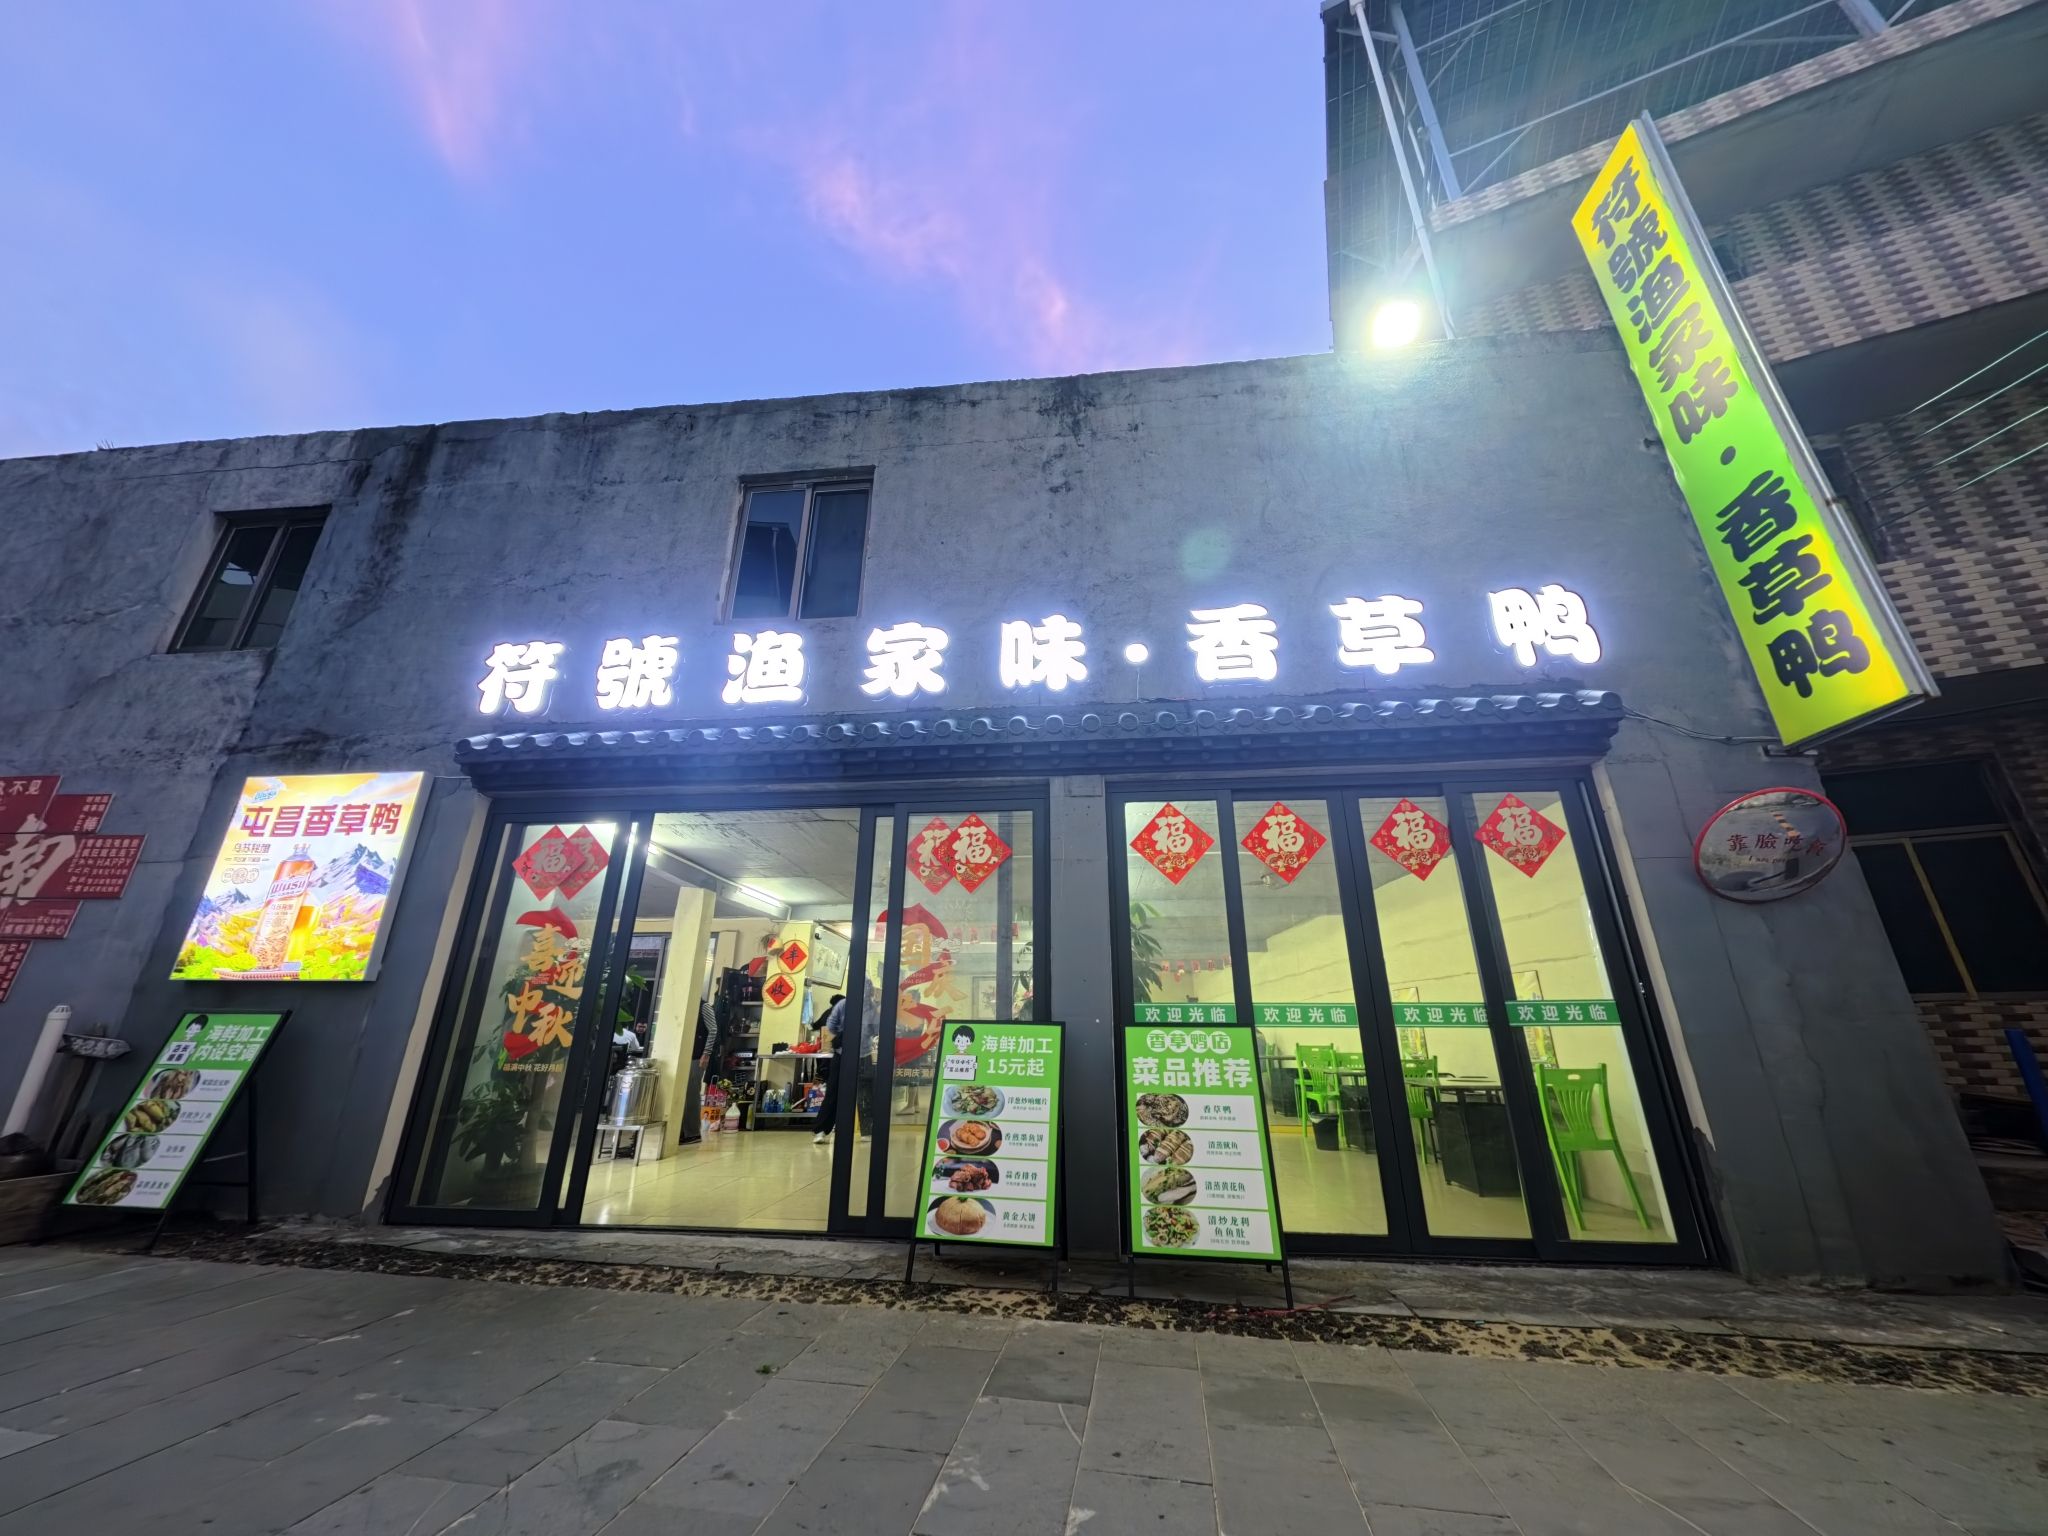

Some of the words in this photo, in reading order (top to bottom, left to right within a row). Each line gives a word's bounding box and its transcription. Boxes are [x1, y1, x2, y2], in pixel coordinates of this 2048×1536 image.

[1592, 157, 1871, 698] 符號渔家味·香草鸭
[240, 802, 402, 838] 屯昌香草鸭
[96, 858, 132, 867] HAPPY
[1145, 1007, 1226, 1023] 欢迎光临
[1264, 1007, 1347, 1023] 欢迎光临
[1404, 1007, 1488, 1023] 欢迎光临
[1517, 1005, 1608, 1021] 欢迎光临
[205, 1024, 270, 1042] 海鲜加工
[1149, 1032, 1229, 1050] 香草鸭店
[192, 1043, 264, 1062] 内设空调
[981, 1035, 1053, 1054] 海鲜加工
[987, 1058, 1045, 1077] 15元起
[1132, 1056, 1253, 1089] 菜品推荐
[1203, 1105, 1232, 1115] 香草鸭
[1004, 1132, 1044, 1142] 香煎墨鱼饼
[1208, 1140, 1239, 1151] 清蒸鱿鱼
[1005, 1170, 1038, 1180] 蒜香排骨
[1204, 1181, 1246, 1192] 清蒸黄花鱼
[1003, 1211, 1036, 1222] 黄金大饼
